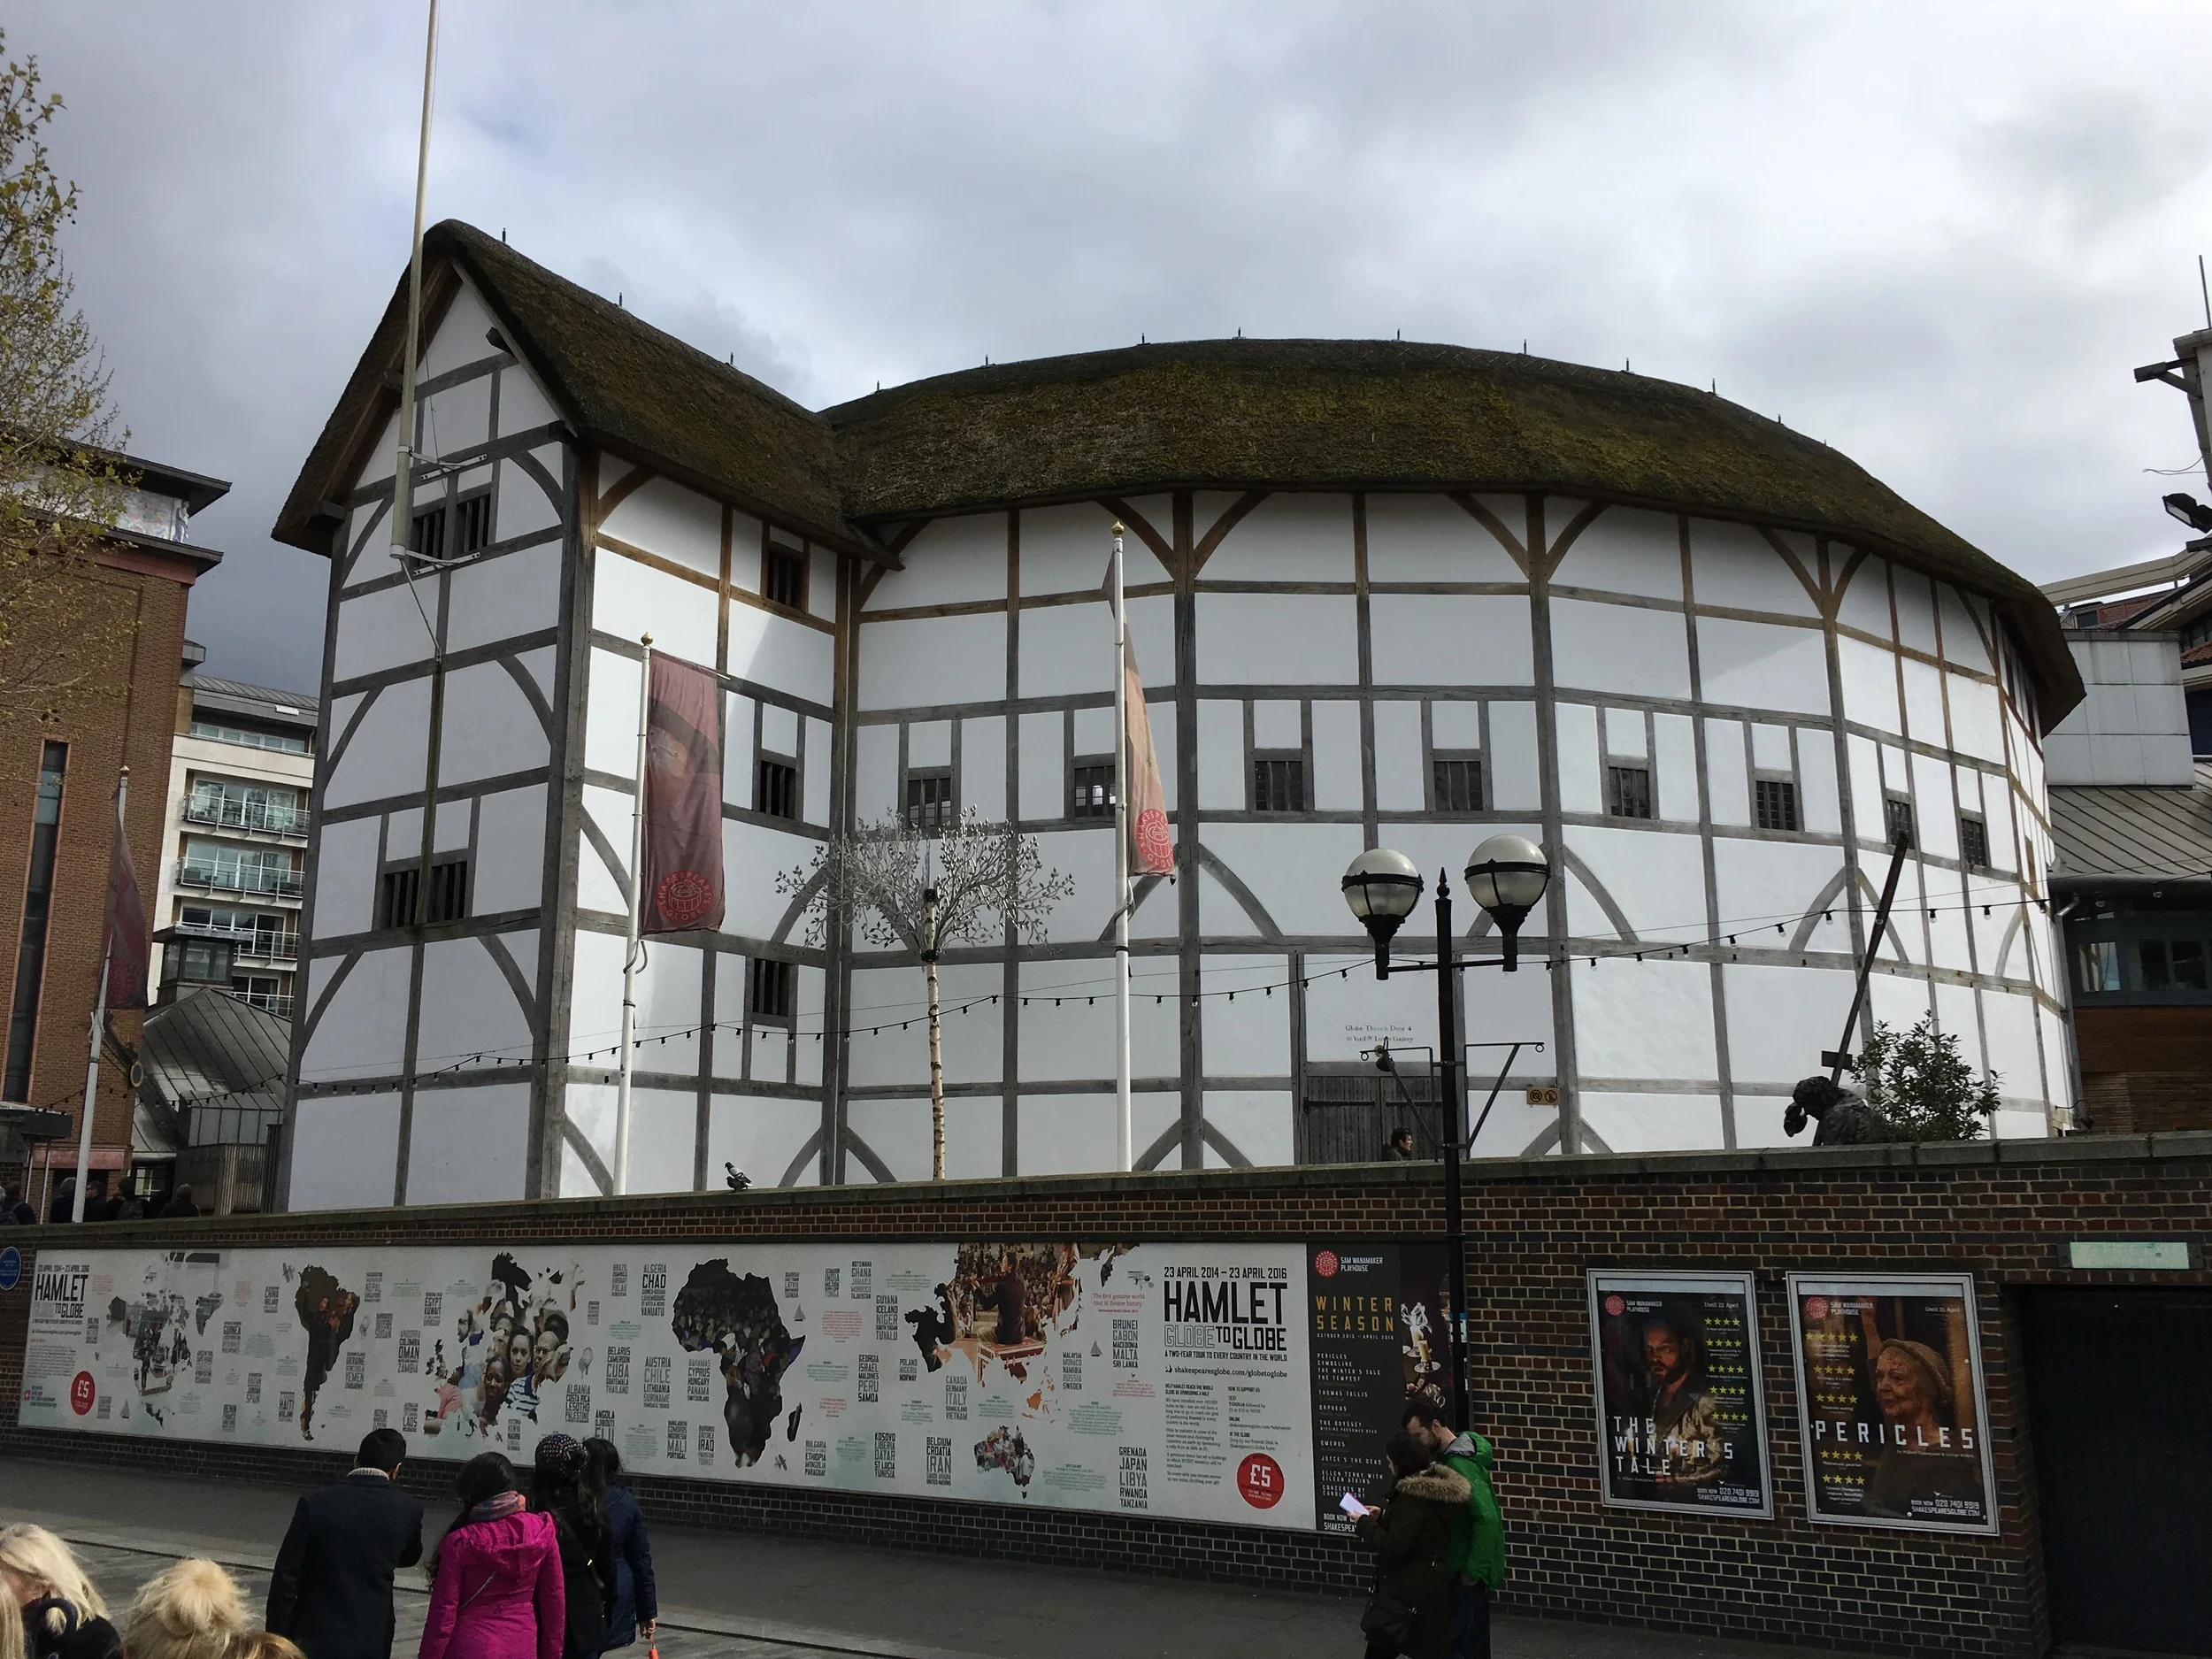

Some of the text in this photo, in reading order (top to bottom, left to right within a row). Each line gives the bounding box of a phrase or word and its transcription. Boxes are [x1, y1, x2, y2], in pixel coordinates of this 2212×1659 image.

[657, 872, 712, 906] SHAKESPEARE'S
[666, 909, 703, 921] GLOBE
[643, 1264, 666, 1273] ALGERIA
[851, 1267, 872, 1277] GHANA
[1164, 1267, 1175, 1278] 23
[1177, 1267, 1199, 1278] APRIL
[1201, 1267, 1219, 1279] 2014
[1229, 1267, 1240, 1279] 23
[1242, 1268, 1265, 1279] APRIL
[1268, 1268, 1287, 1279] 2016
[642, 1273, 666, 1288] CHAD
[35, 1274, 88, 1302] HAMLET
[425, 1297, 442, 1307] EGYPT
[876, 1295, 898, 1304] GUYANA
[1164, 1280, 1287, 1325] HAMLET
[1316, 1295, 1392, 1312] WINTER
[61, 1303, 84, 1318] GLOBE
[641, 1307, 664, 1317] VANUATU
[876, 1305, 898, 1314] ICELAND
[876, 1313, 898, 1325] NIGER
[1113, 1319, 1138, 1330] BRUNEI
[1317, 1315, 1394, 1332] SEASON
[876, 1331, 898, 1340] TUVALU
[1113, 1330, 1138, 1340] GABON
[1164, 1325, 1286, 1351] GLOBE TO GLOBE
[398, 1346, 420, 1359] OMAN
[608, 1346, 631, 1356] BELARUS
[1113, 1348, 1138, 1360] MALTA
[1169, 1350, 1193, 1359] TWO-YEAR
[1270, 1354, 1287, 1363] WORLD
[645, 1356, 672, 1368] AUSTRIA
[858, 1363, 879, 1372] ISRAEL
[606, 1363, 629, 1379] CUBA
[644, 1368, 671, 1384] CHILE
[688, 1367, 710, 1378] CYPRUS
[1174, 1367, 1287, 1379] shakespearesglobe.com/globetoglobe
[899, 1373, 917, 1382] NORWAY
[945, 1375, 967, 1385] CANADA
[77, 1379, 90, 1398] £5
[566, 1385, 590, 1394] ALBANIA
[643, 1383, 670, 1394] LITHUANIA
[858, 1380, 879, 1393] PERU
[858, 1393, 879, 1402] SAMOA
[945, 1393, 967, 1405] ITALY
[280, 1399, 295, 1410] HAITI
[565, 1402, 590, 1411] LESOTHO
[595, 1409, 615, 1419] ANGOLA
[1613, 1416, 1655, 1434] THE
[874, 1432, 895, 1442] KOSOVO
[1815, 1420, 1973, 1449] PERICLES
[668, 1439, 687, 1453] MALI
[698, 1439, 715, 1452] IRAQ
[874, 1441, 895, 1450] LIBERIA
[926, 1436, 951, 1447] BELGIUM
[926, 1446, 951, 1456] CROATIA
[1119, 1447, 1147, 1457] GRENADA
[1615, 1436, 1733, 1460] WINTER'S
[805, 1452, 826, 1462] ETHIOPIA
[874, 1450, 895, 1462] QATAR
[926, 1455, 951, 1473] IRAN
[1119, 1457, 1148, 1471] JAPAN
[1616, 1456, 1671, 1476] TALE
[1119, 1471, 1148, 1487] LIBYA
[1250, 1463, 1271, 1487] £5
[1120, 1487, 1148, 1499] RWANDA
[1120, 1499, 1148, 1509] TANZANIA
[1964, 1501, 1979, 1509] 9919
[1911, 1506, 1980, 1517] SHAKESPEARESGLOBE.COM
[1324, 1522, 1357, 1532] SHAKESPEA
